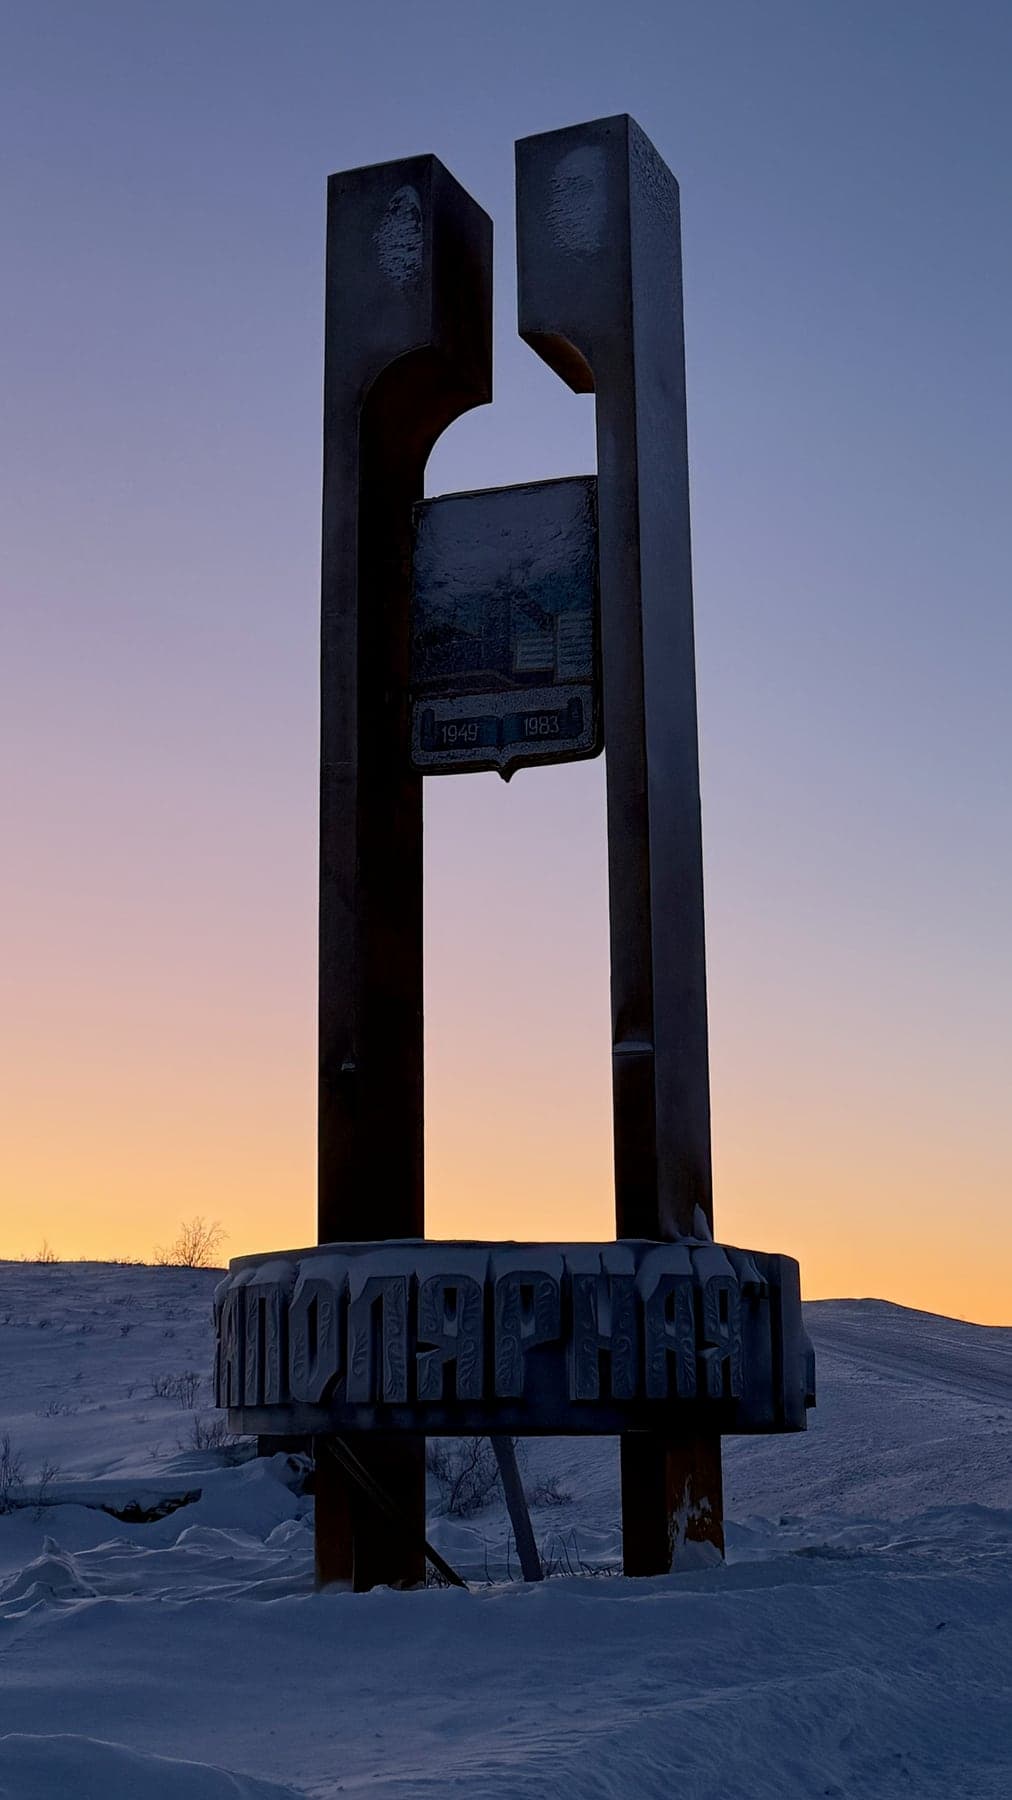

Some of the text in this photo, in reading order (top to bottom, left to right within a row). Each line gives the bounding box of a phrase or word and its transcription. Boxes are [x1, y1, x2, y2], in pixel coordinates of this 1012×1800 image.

[441, 723, 479, 744] 1949
[524, 715, 561, 737] 1983
[214, 1270, 745, 1408] АПОЛЯРНАЯ
